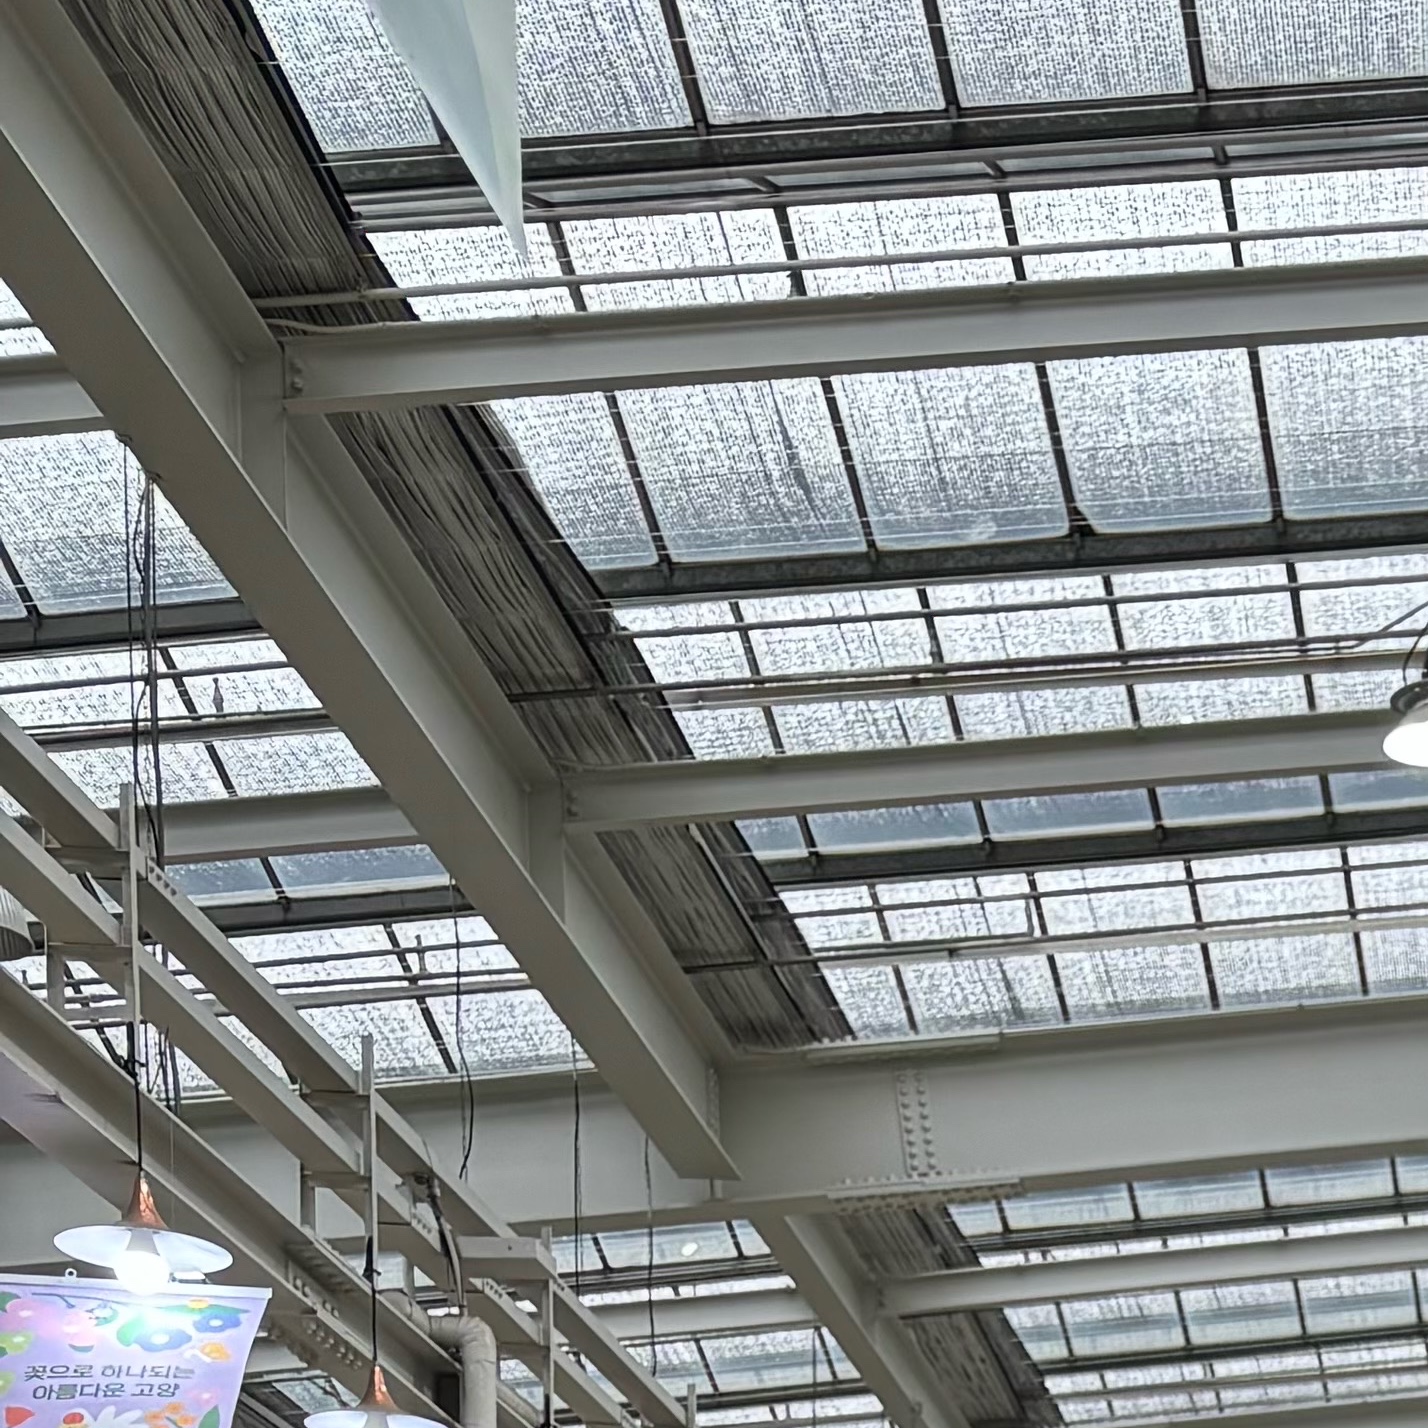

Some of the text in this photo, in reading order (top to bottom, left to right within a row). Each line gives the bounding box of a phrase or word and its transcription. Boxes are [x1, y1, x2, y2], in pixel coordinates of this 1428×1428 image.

[24, 1365, 195, 1381] 꽃으로 하나되는
[32, 1383, 180, 1400] 아름다운 고양
